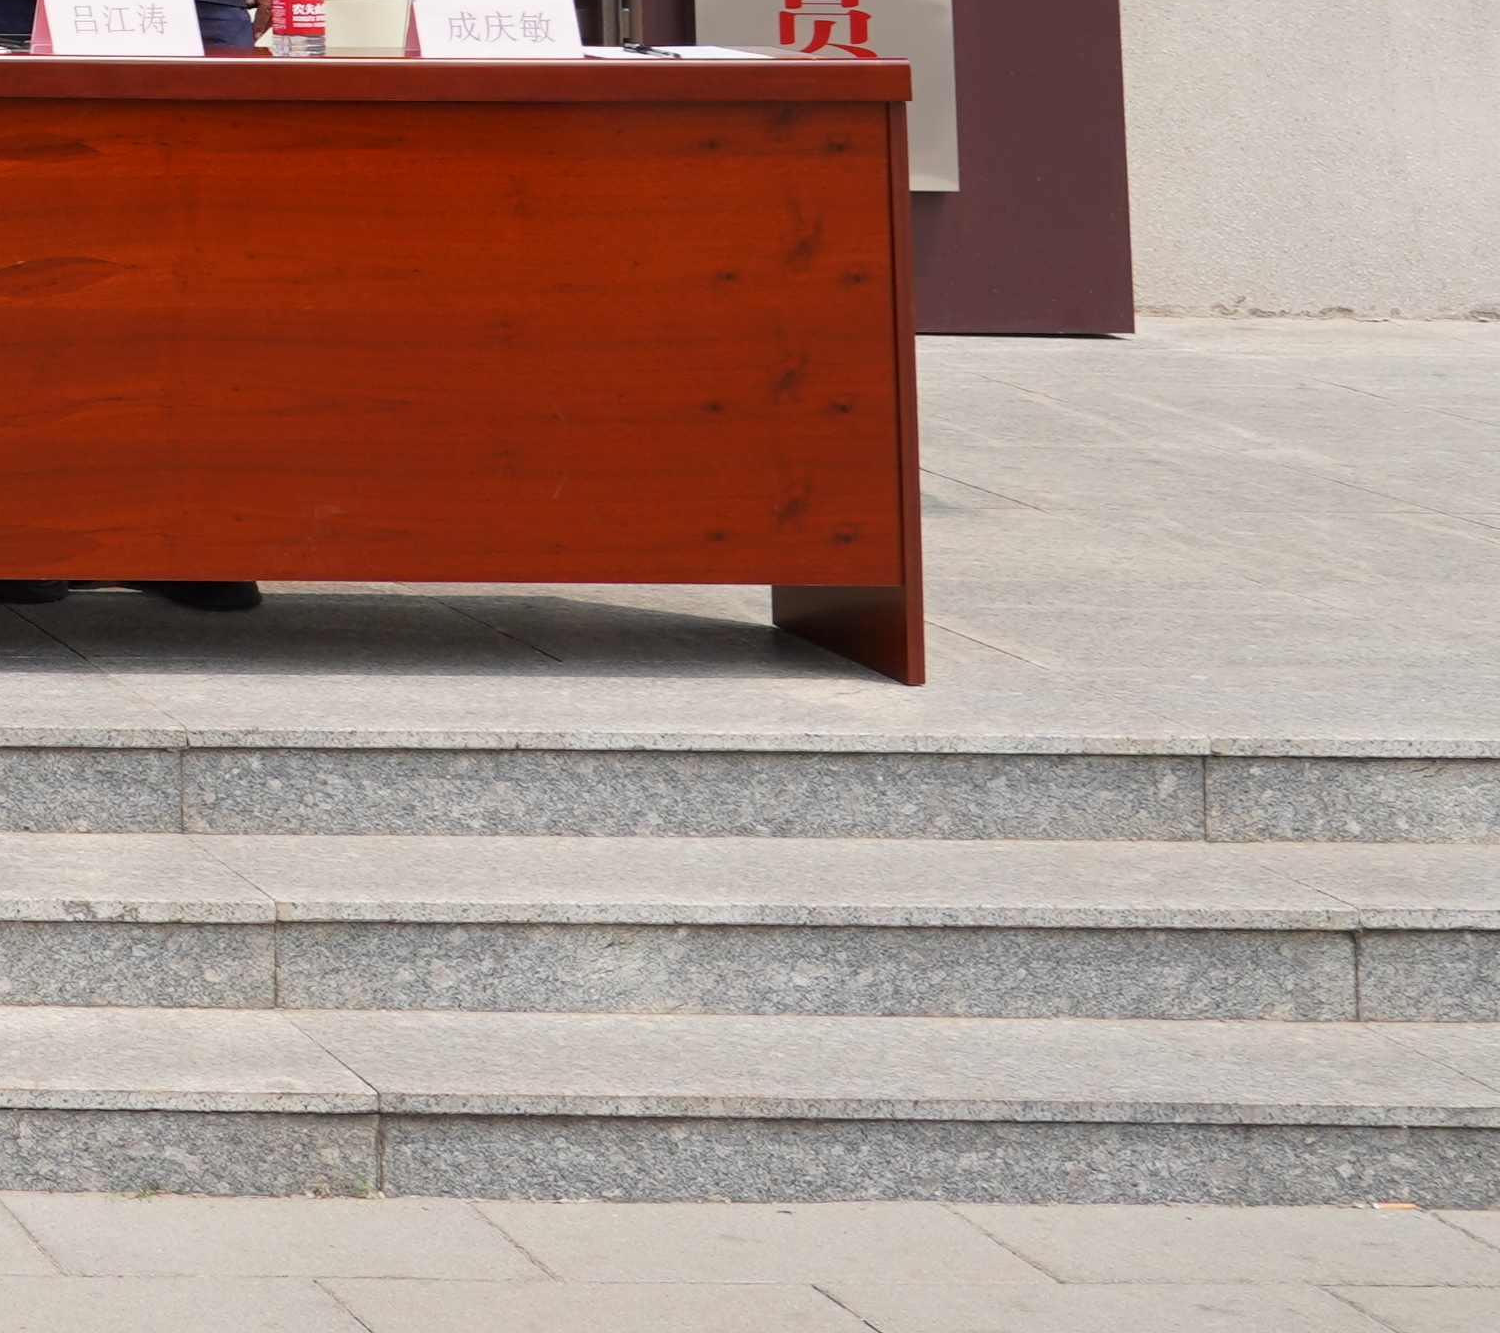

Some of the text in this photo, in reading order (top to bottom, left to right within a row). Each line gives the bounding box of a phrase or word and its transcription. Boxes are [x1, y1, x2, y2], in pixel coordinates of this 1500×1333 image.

[72, 2, 169, 35] 吕江涛
[447, 9, 557, 43] 成庆敏
